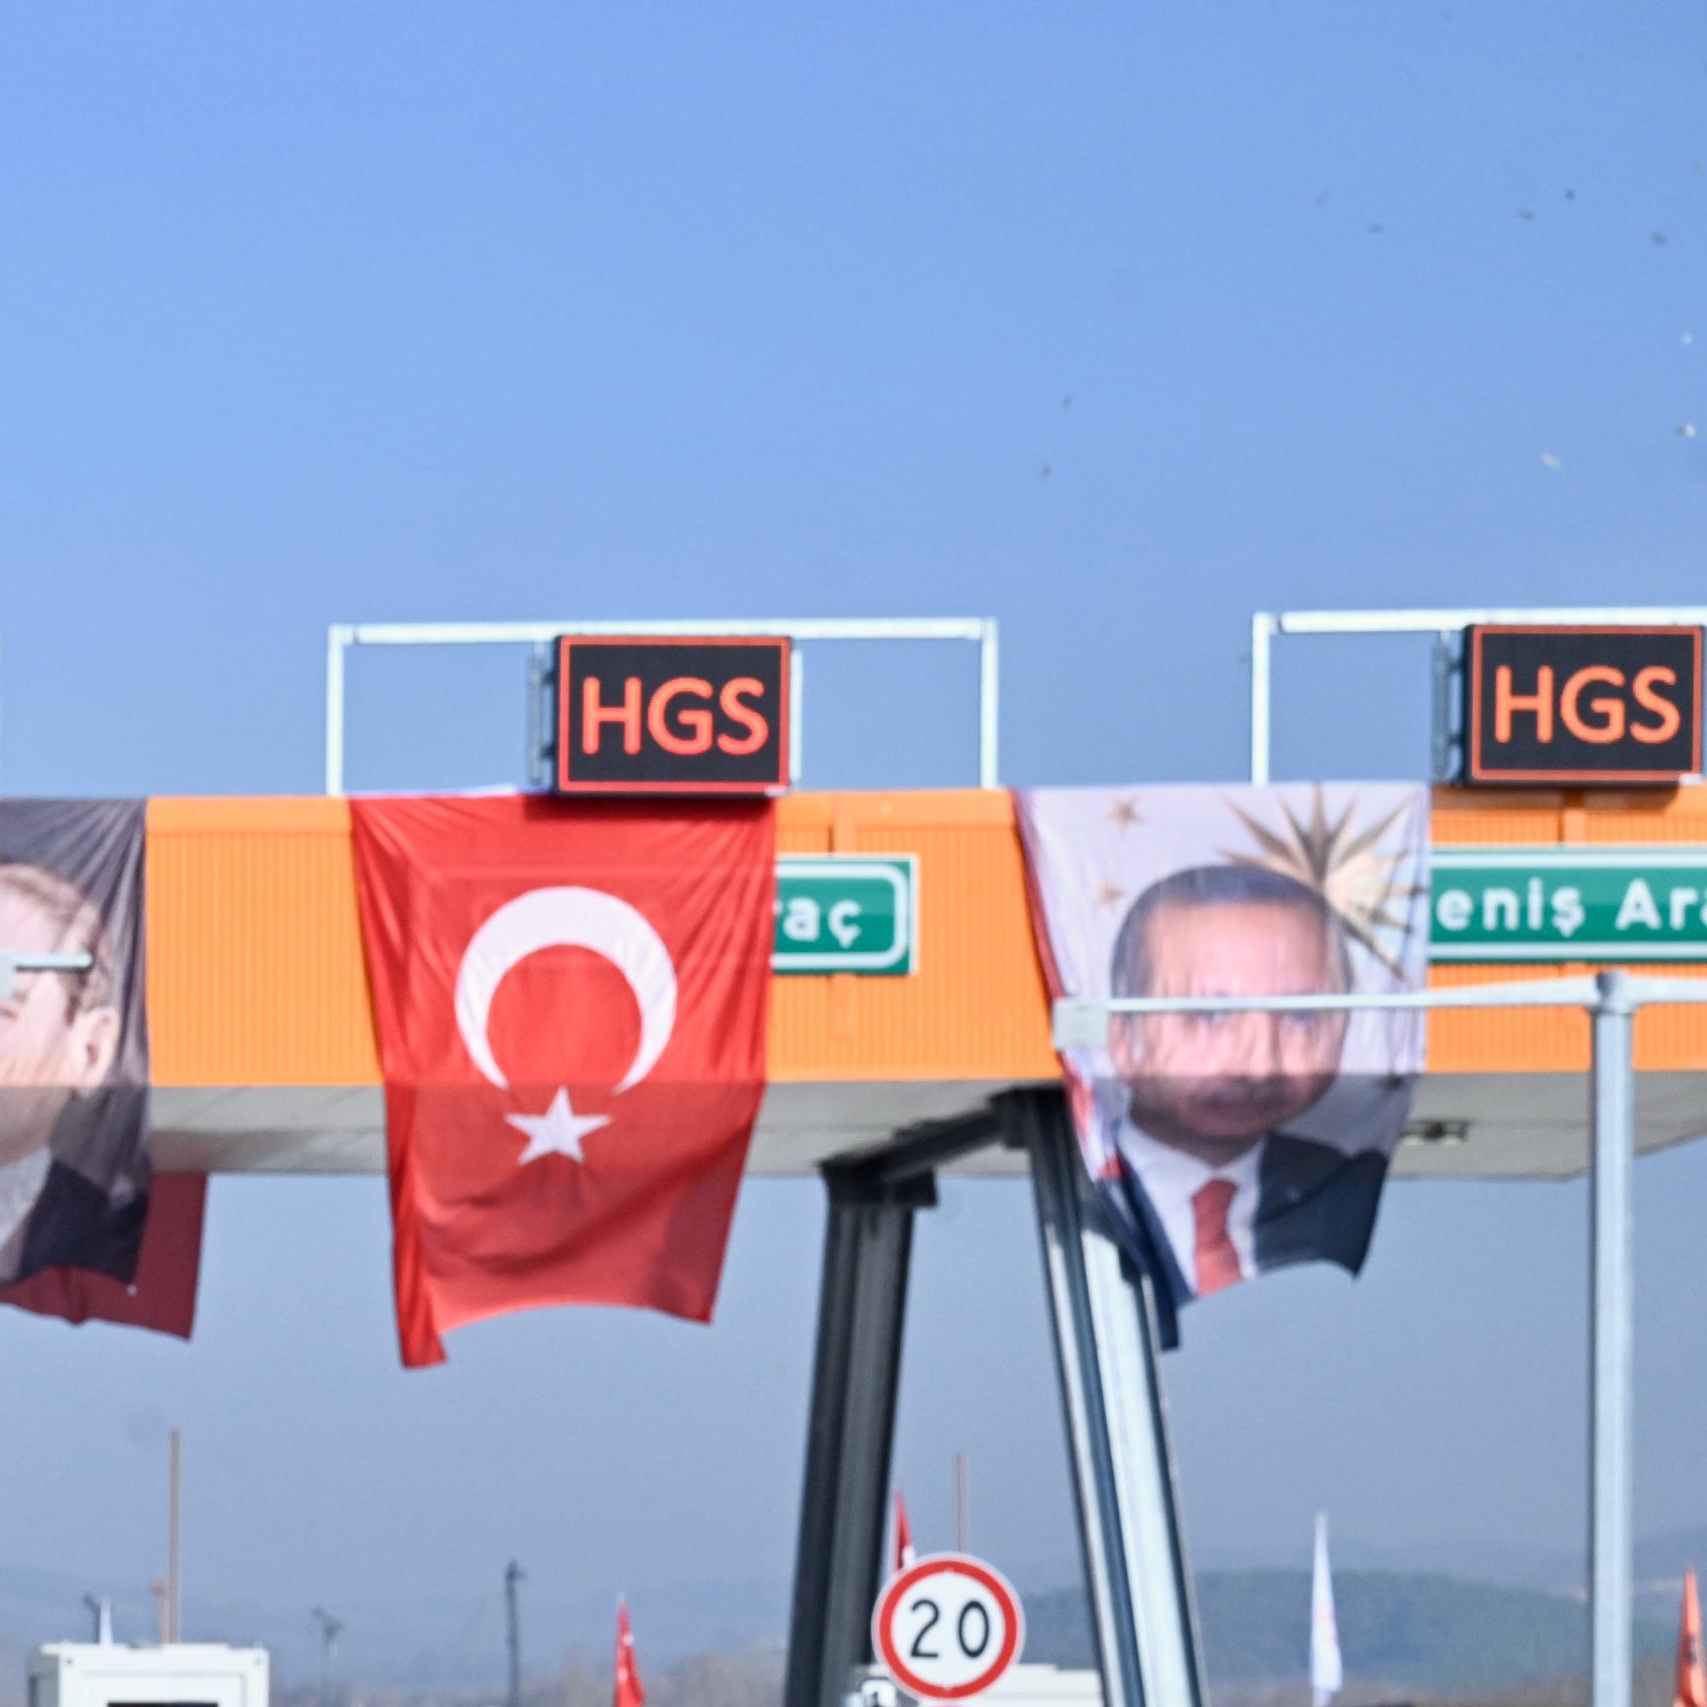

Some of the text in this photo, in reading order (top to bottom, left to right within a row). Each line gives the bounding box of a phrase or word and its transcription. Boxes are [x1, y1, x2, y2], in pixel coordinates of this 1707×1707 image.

[582, 677, 769, 755] HGS
[1495, 665, 1680, 744] HGS
[773, 897, 862, 949] aç
[1436, 877, 1707, 938] eniş Ar
[911, 1599, 990, 1658] 20
